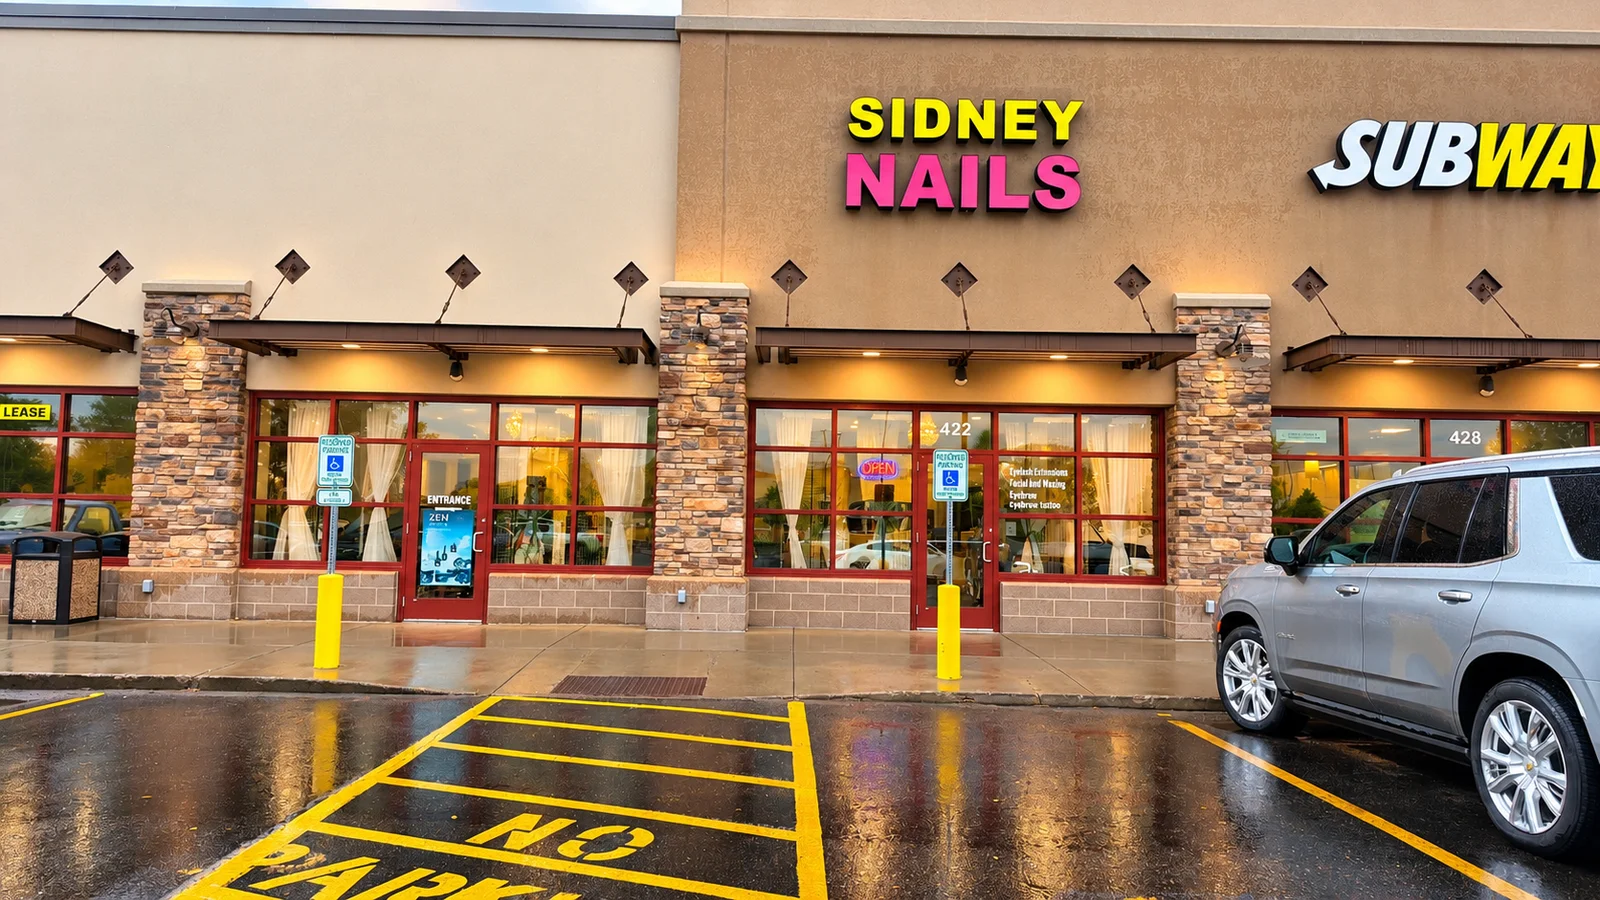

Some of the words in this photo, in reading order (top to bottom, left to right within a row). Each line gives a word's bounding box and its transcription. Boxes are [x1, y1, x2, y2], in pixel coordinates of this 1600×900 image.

[848, 97, 1084, 142] SIDNEY
[846, 153, 1082, 211] NAILS
[3, 406, 46, 418] LEASE
[939, 421, 972, 436] 422
[1449, 430, 1482, 445] 428
[861, 461, 896, 475] OPEN
[427, 494, 472, 505] ENTRANCE
[429, 513, 449, 522] ZEN
[464, 812, 655, 861] NO
